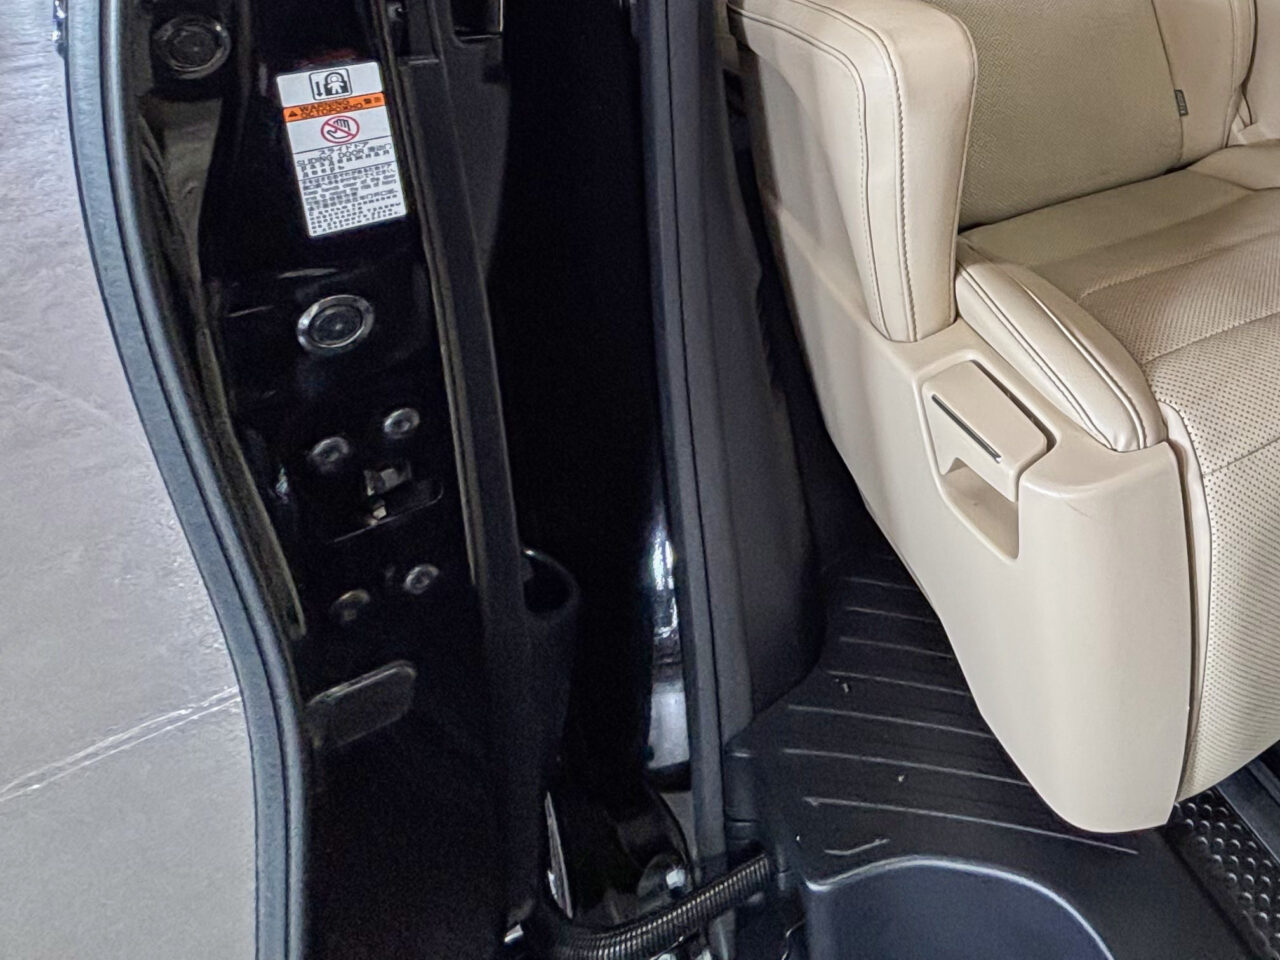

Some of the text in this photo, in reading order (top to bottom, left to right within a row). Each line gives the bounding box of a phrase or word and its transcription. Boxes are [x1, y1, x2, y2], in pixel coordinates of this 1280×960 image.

[298, 98, 349, 112] WARNING
[296, 154, 332, 166] SLIDING
[337, 148, 364, 158] DOOR
